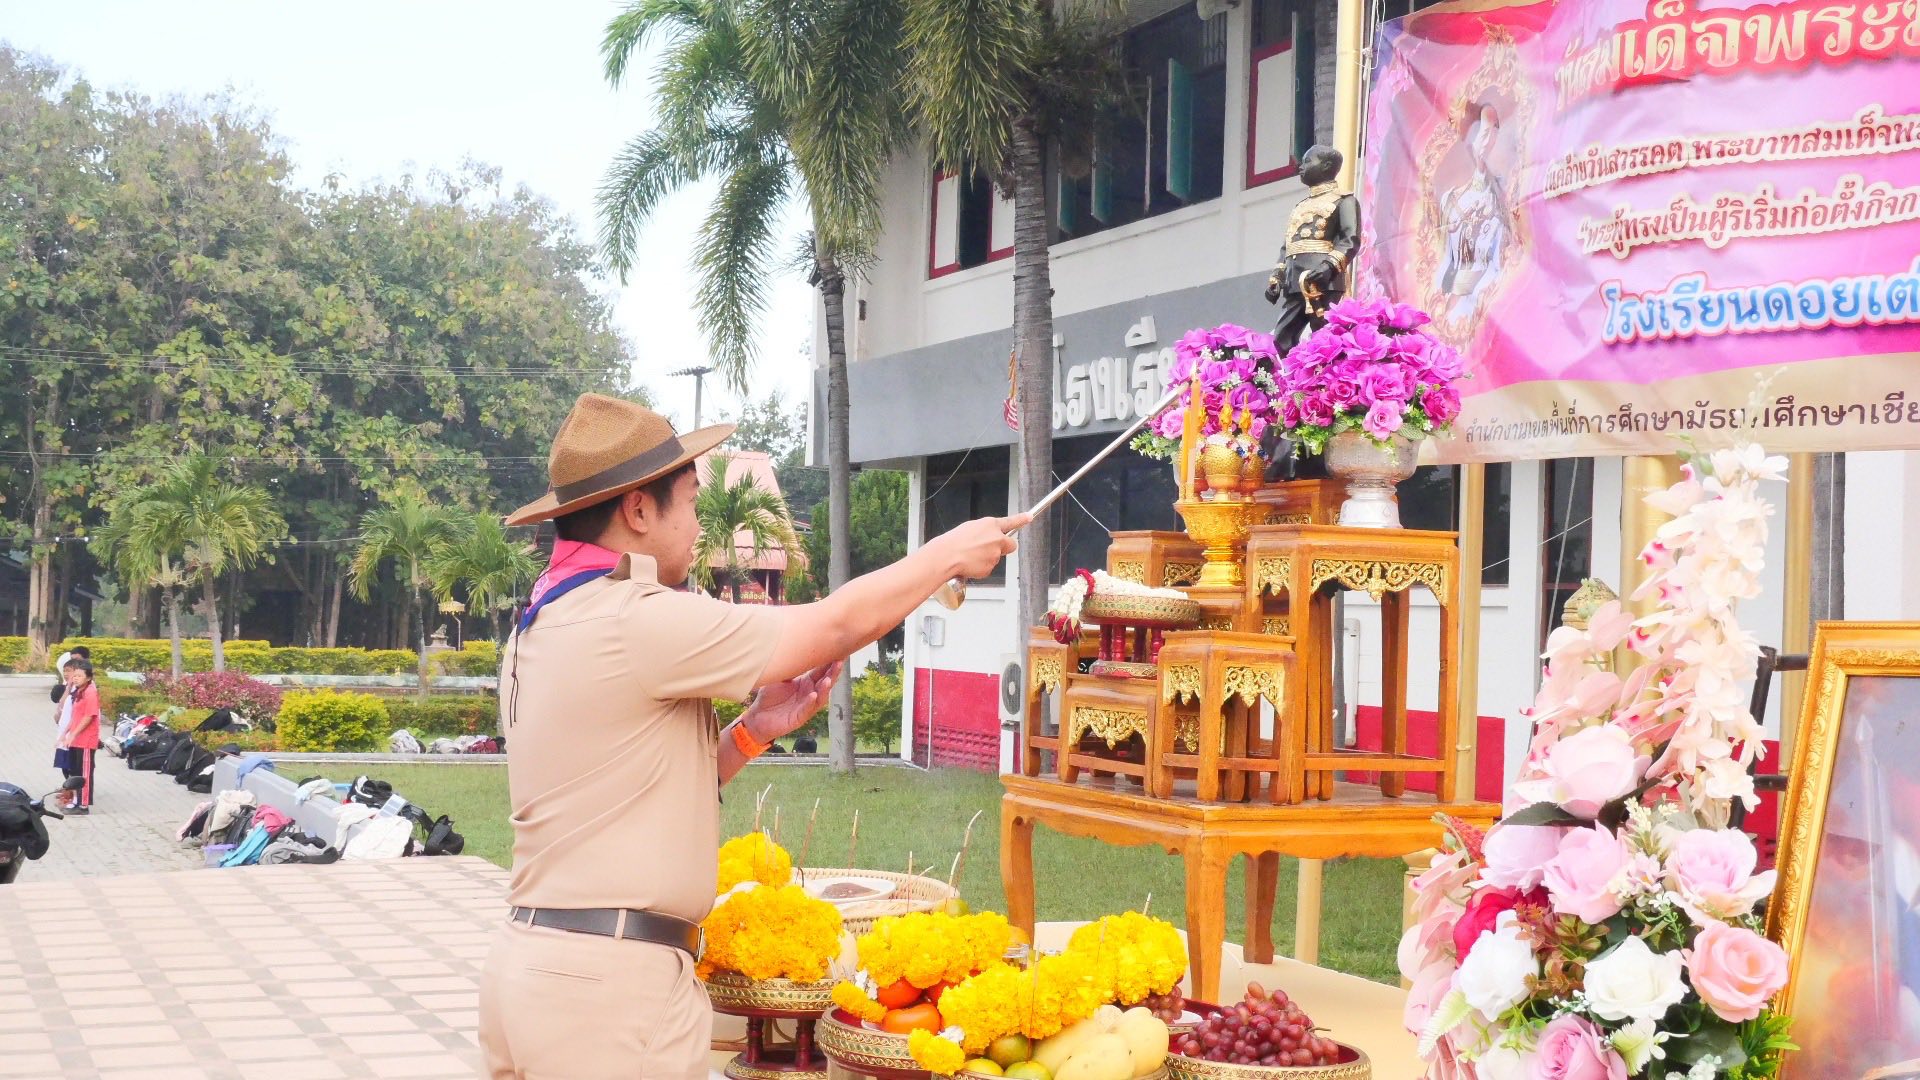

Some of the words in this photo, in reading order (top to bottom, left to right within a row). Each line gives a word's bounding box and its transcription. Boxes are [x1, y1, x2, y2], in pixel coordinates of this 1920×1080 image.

[1692, 110, 1920, 160] พระบาทสมเด็จพ
[1580, 181, 1920, 253] “พระผู้ทรงเป็นผู้ริเริ่มก่อตั้งกิจก
